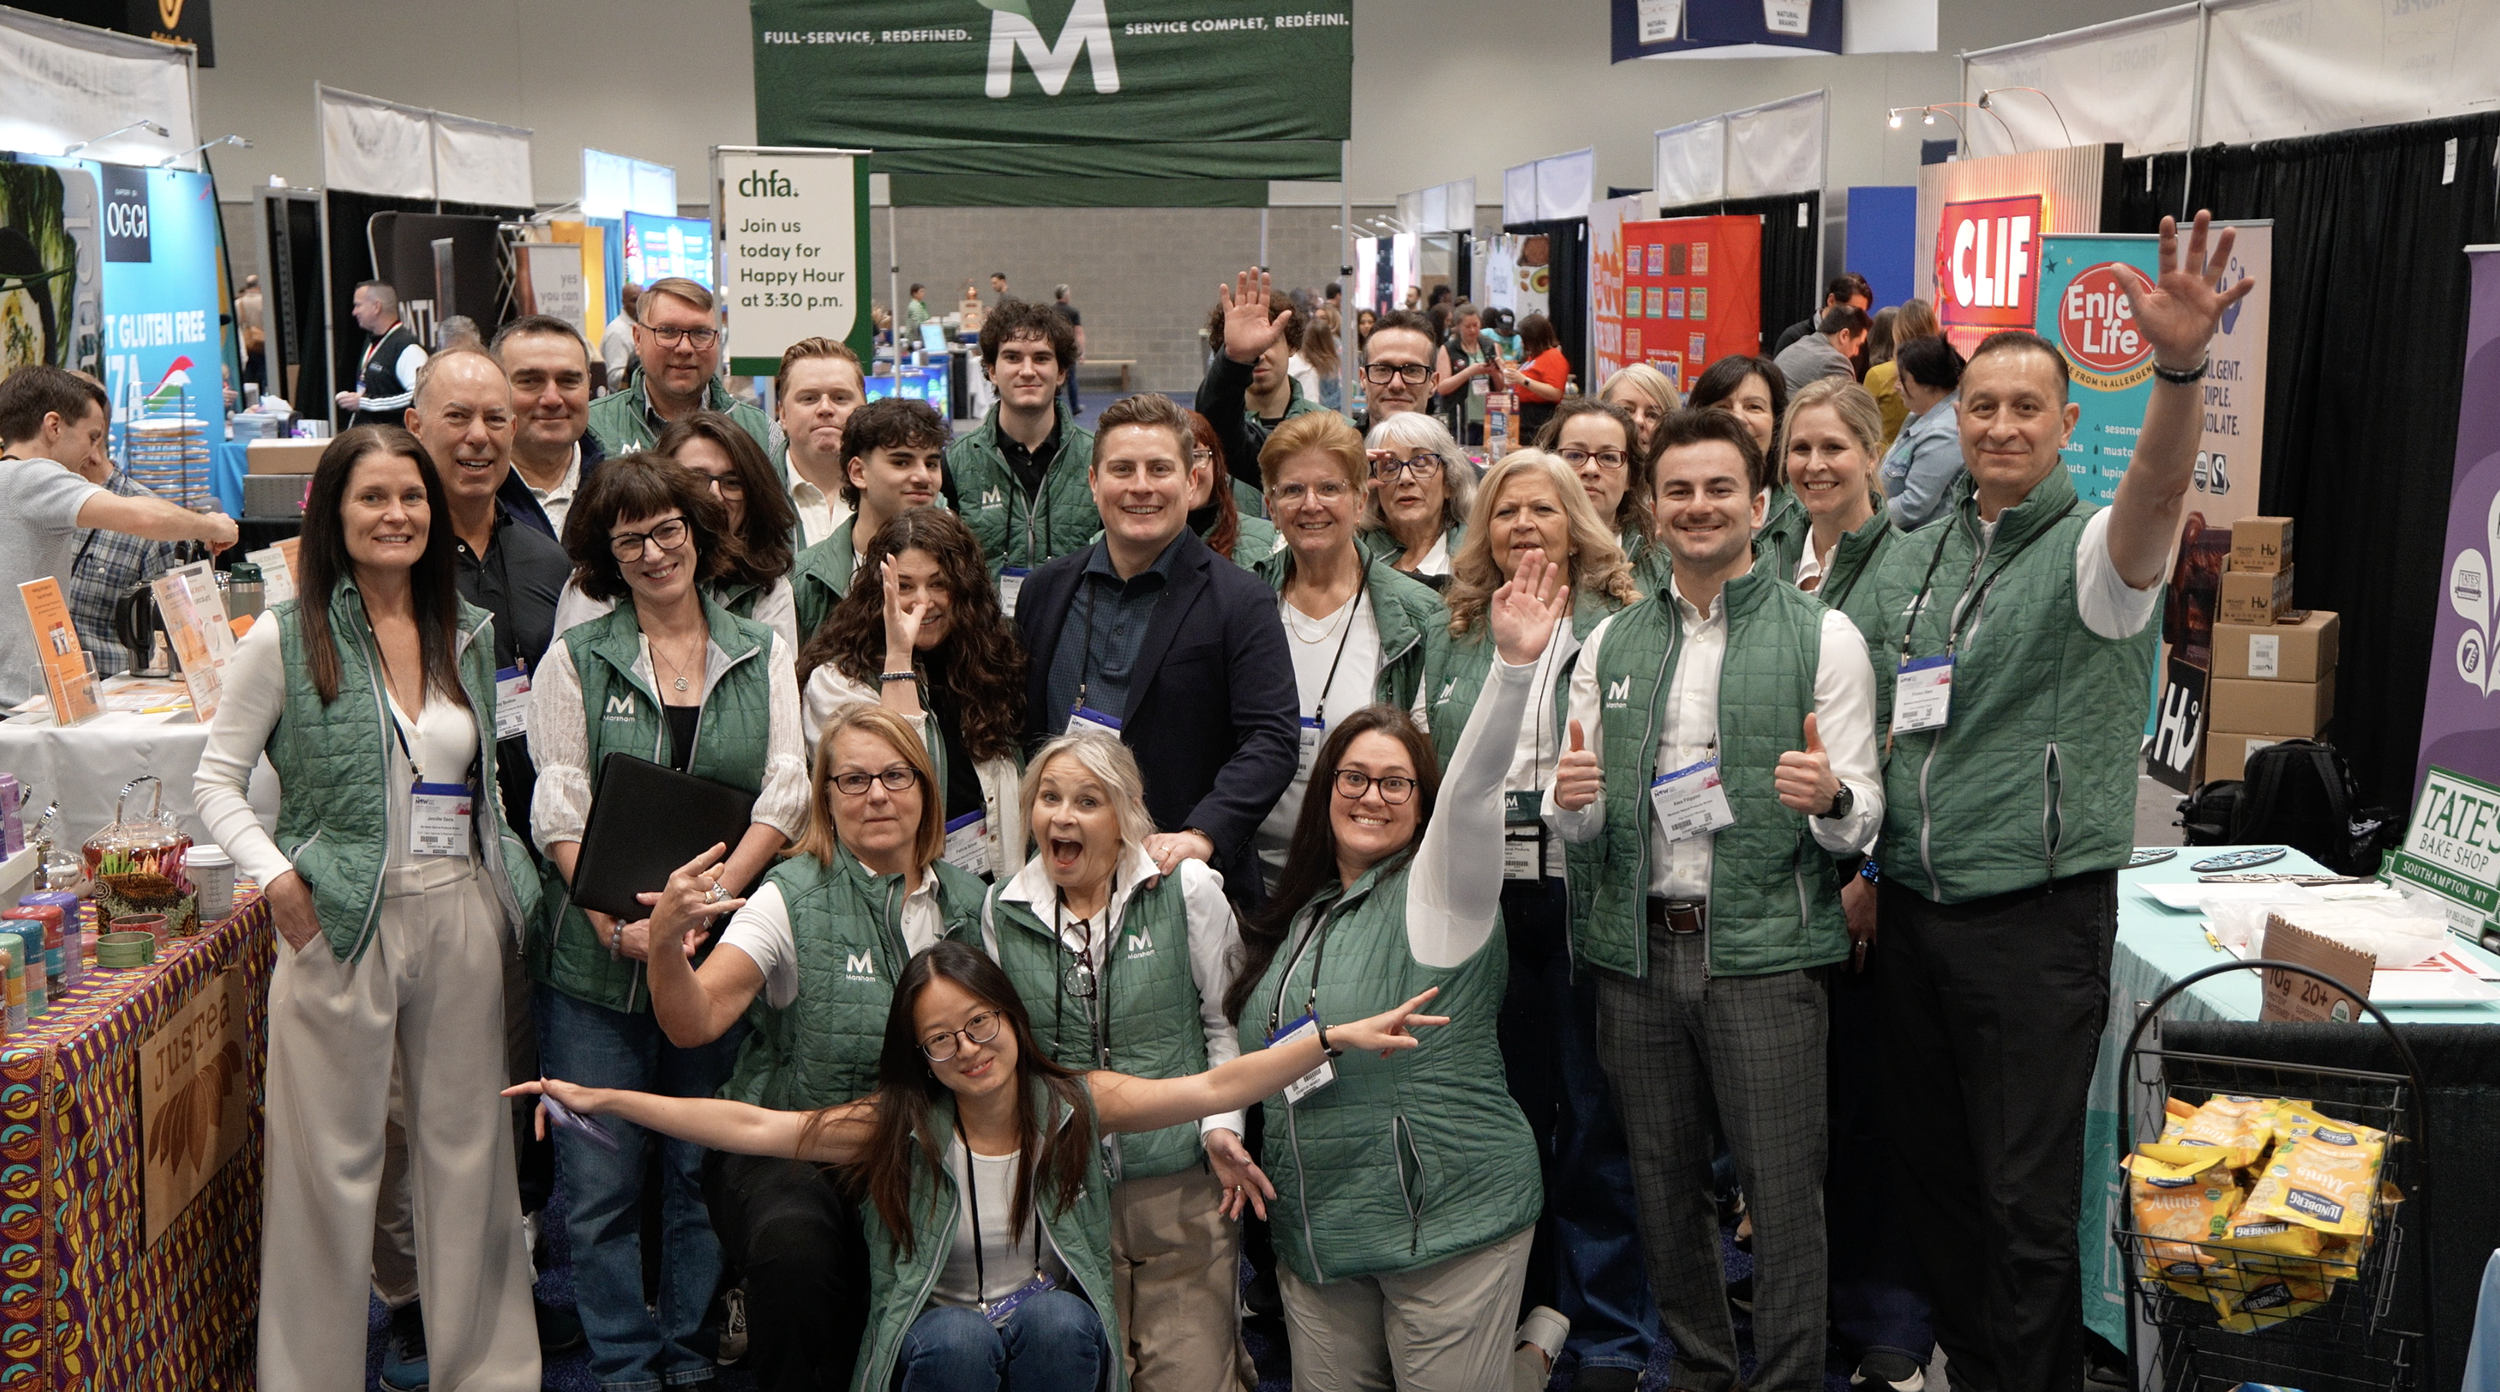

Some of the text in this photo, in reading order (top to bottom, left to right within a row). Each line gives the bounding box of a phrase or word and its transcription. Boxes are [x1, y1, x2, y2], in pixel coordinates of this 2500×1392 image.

[1125, 11, 1349, 35] SERVICE COMPLET, REDÉFINI.
[1777, 10, 1799, 19] NATURAL
[1778, 19, 1798, 28] BRANDS
[764, 29, 973, 45] FULL-SERVICE, REDEFINED.
[107, 201, 148, 239] OGGI
[740, 218, 802, 233] Join us
[740, 243, 821, 261] today for
[1953, 215, 2031, 308] CLIF
[560, 274, 577, 288] yes
[741, 268, 845, 286] Happy Hour
[540, 292, 579, 306] you can
[741, 292, 843, 311] at 3:30 p.m.
[2068, 282, 2134, 327] Enjo
[119, 312, 173, 349] GLUTEN
[175, 310, 206, 344] FREE
[2083, 319, 2139, 355] Life
[2075, 370, 2098, 386] FROM
[2100, 379, 2108, 388] 14
[2110, 364, 2154, 388] ALLERGEN
[2105, 425, 2141, 435] sesame
[2103, 447, 2134, 457] musta
[603, 714, 636, 723] Marsham
[2420, 833, 2489, 872] BAKE SHOP
[2402, 860, 2471, 898] SOUTHAMPTON,
[2474, 889, 2489, 904] NY
[2452, 911, 2476, 928] DELICIOUS
[1127, 949, 1156, 960] Marsham
[845, 973, 875, 982] Marsham
[2270, 968, 2328, 1006] 10g 20+
[2296, 1166, 2356, 1194] Minis
[2144, 1194, 2201, 1212] Minis
[2290, 1191, 2342, 1220] LUNDBERG
